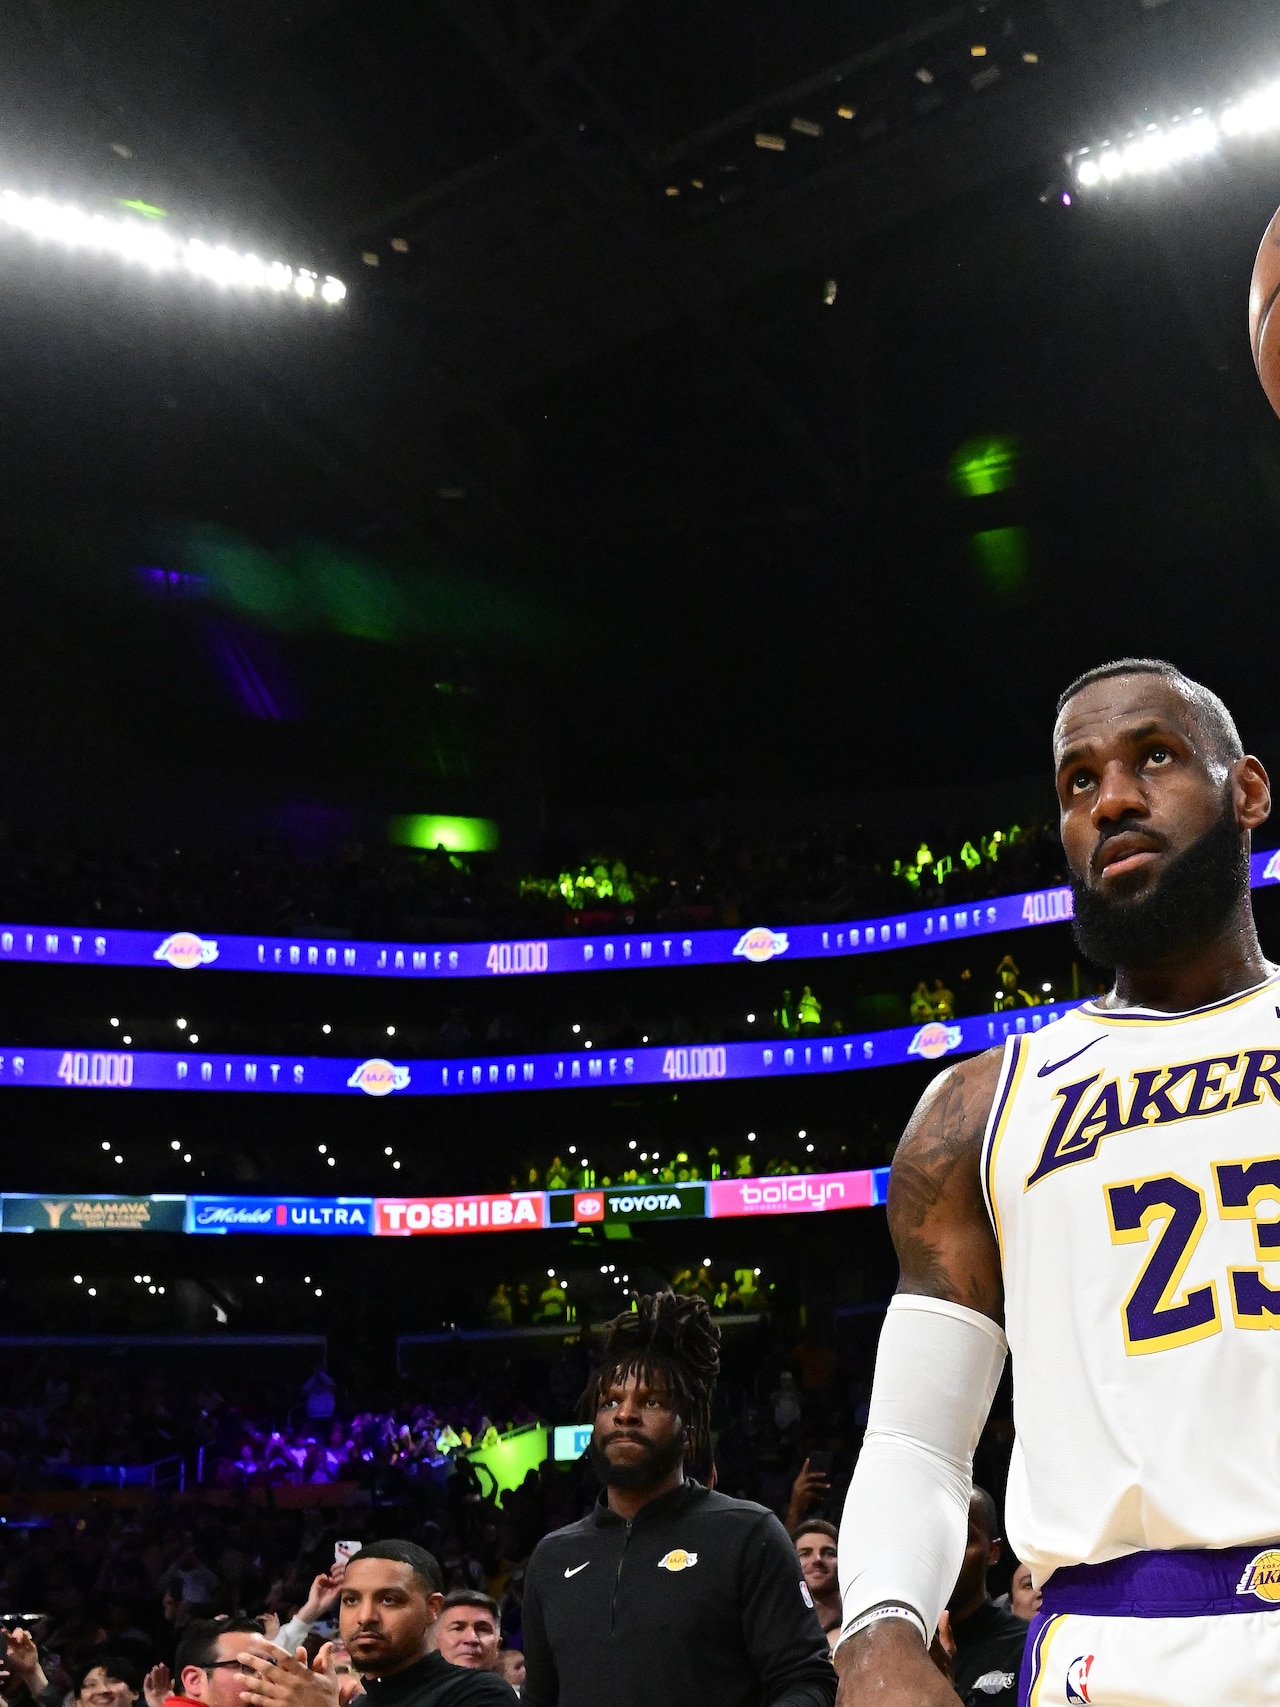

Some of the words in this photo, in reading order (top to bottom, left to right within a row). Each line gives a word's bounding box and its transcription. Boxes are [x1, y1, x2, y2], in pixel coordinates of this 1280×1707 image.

[924, 907, 996, 934] JAMES
[377, 950, 458, 968] JAMES
[584, 939, 692, 961] POINTS
[177, 1061, 304, 1082] POINTS
[555, 1057, 634, 1078] JAMES
[763, 1041, 873, 1065] POINTS
[609, 1194, 682, 1213] TOYOTA
[740, 1181, 845, 1208] boldyn
[197, 1206, 274, 1225] Michelob
[291, 1207, 365, 1225] ULTRA
[383, 1199, 537, 1229] TOSHIBA
